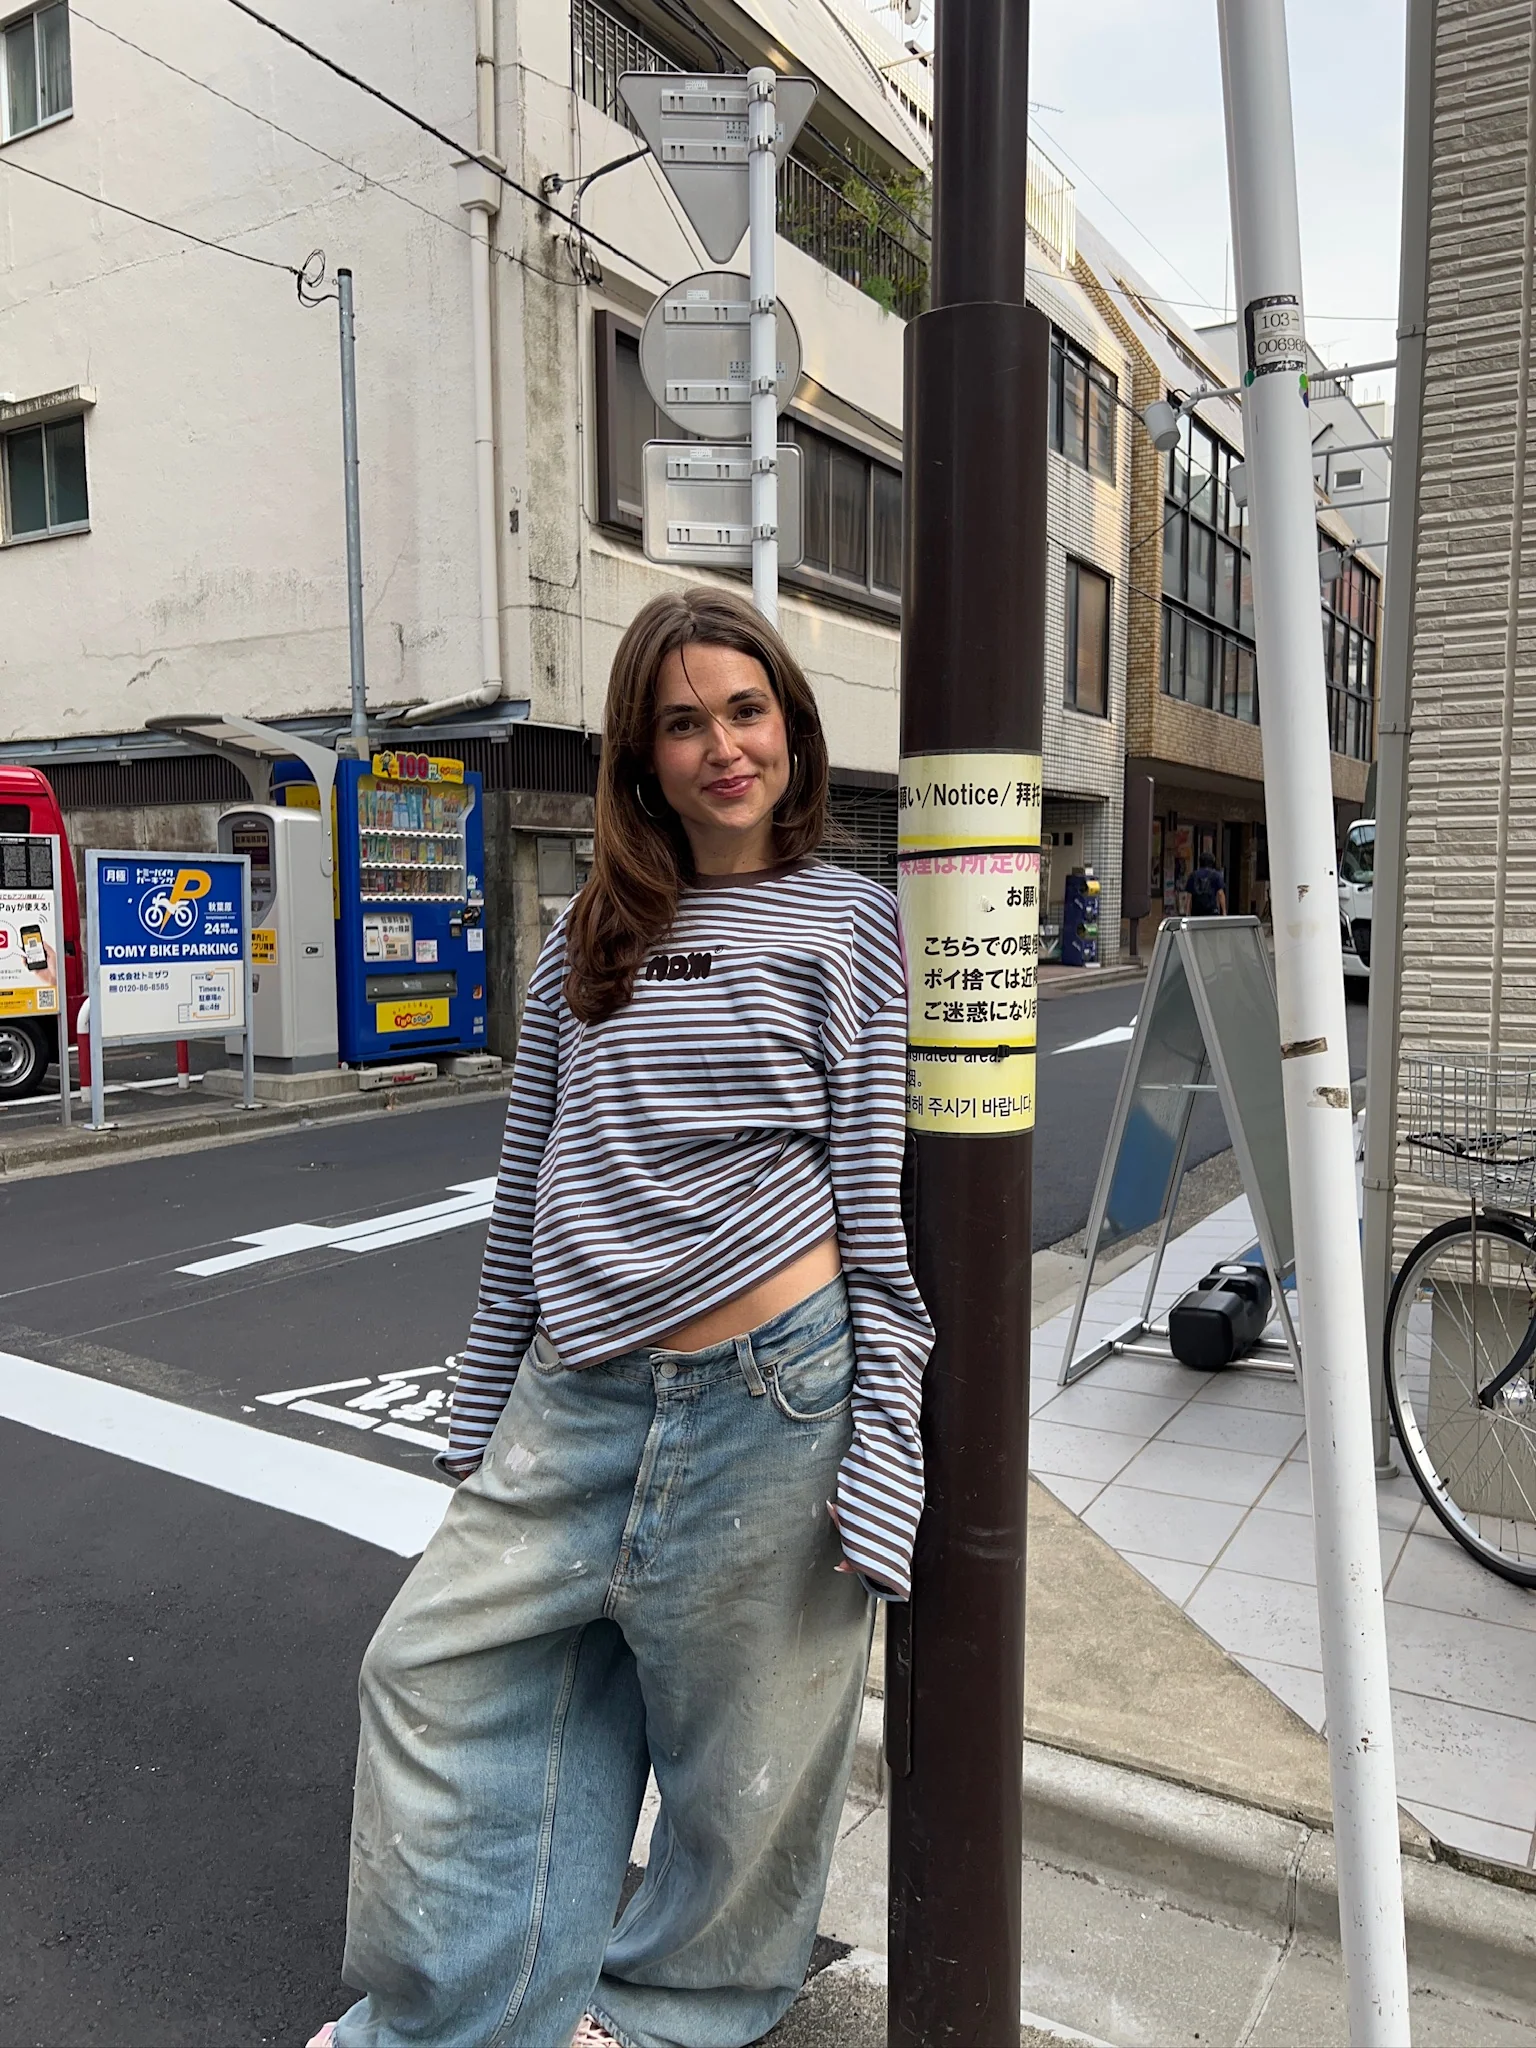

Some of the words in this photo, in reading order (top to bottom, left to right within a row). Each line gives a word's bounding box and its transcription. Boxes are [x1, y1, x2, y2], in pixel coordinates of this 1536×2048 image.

[105, 945, 147, 958] TOMY
[150, 944, 180, 957] BIKE
[182, 943, 239, 956] PARKING
[927, 1097, 976, 1118] 주시기
